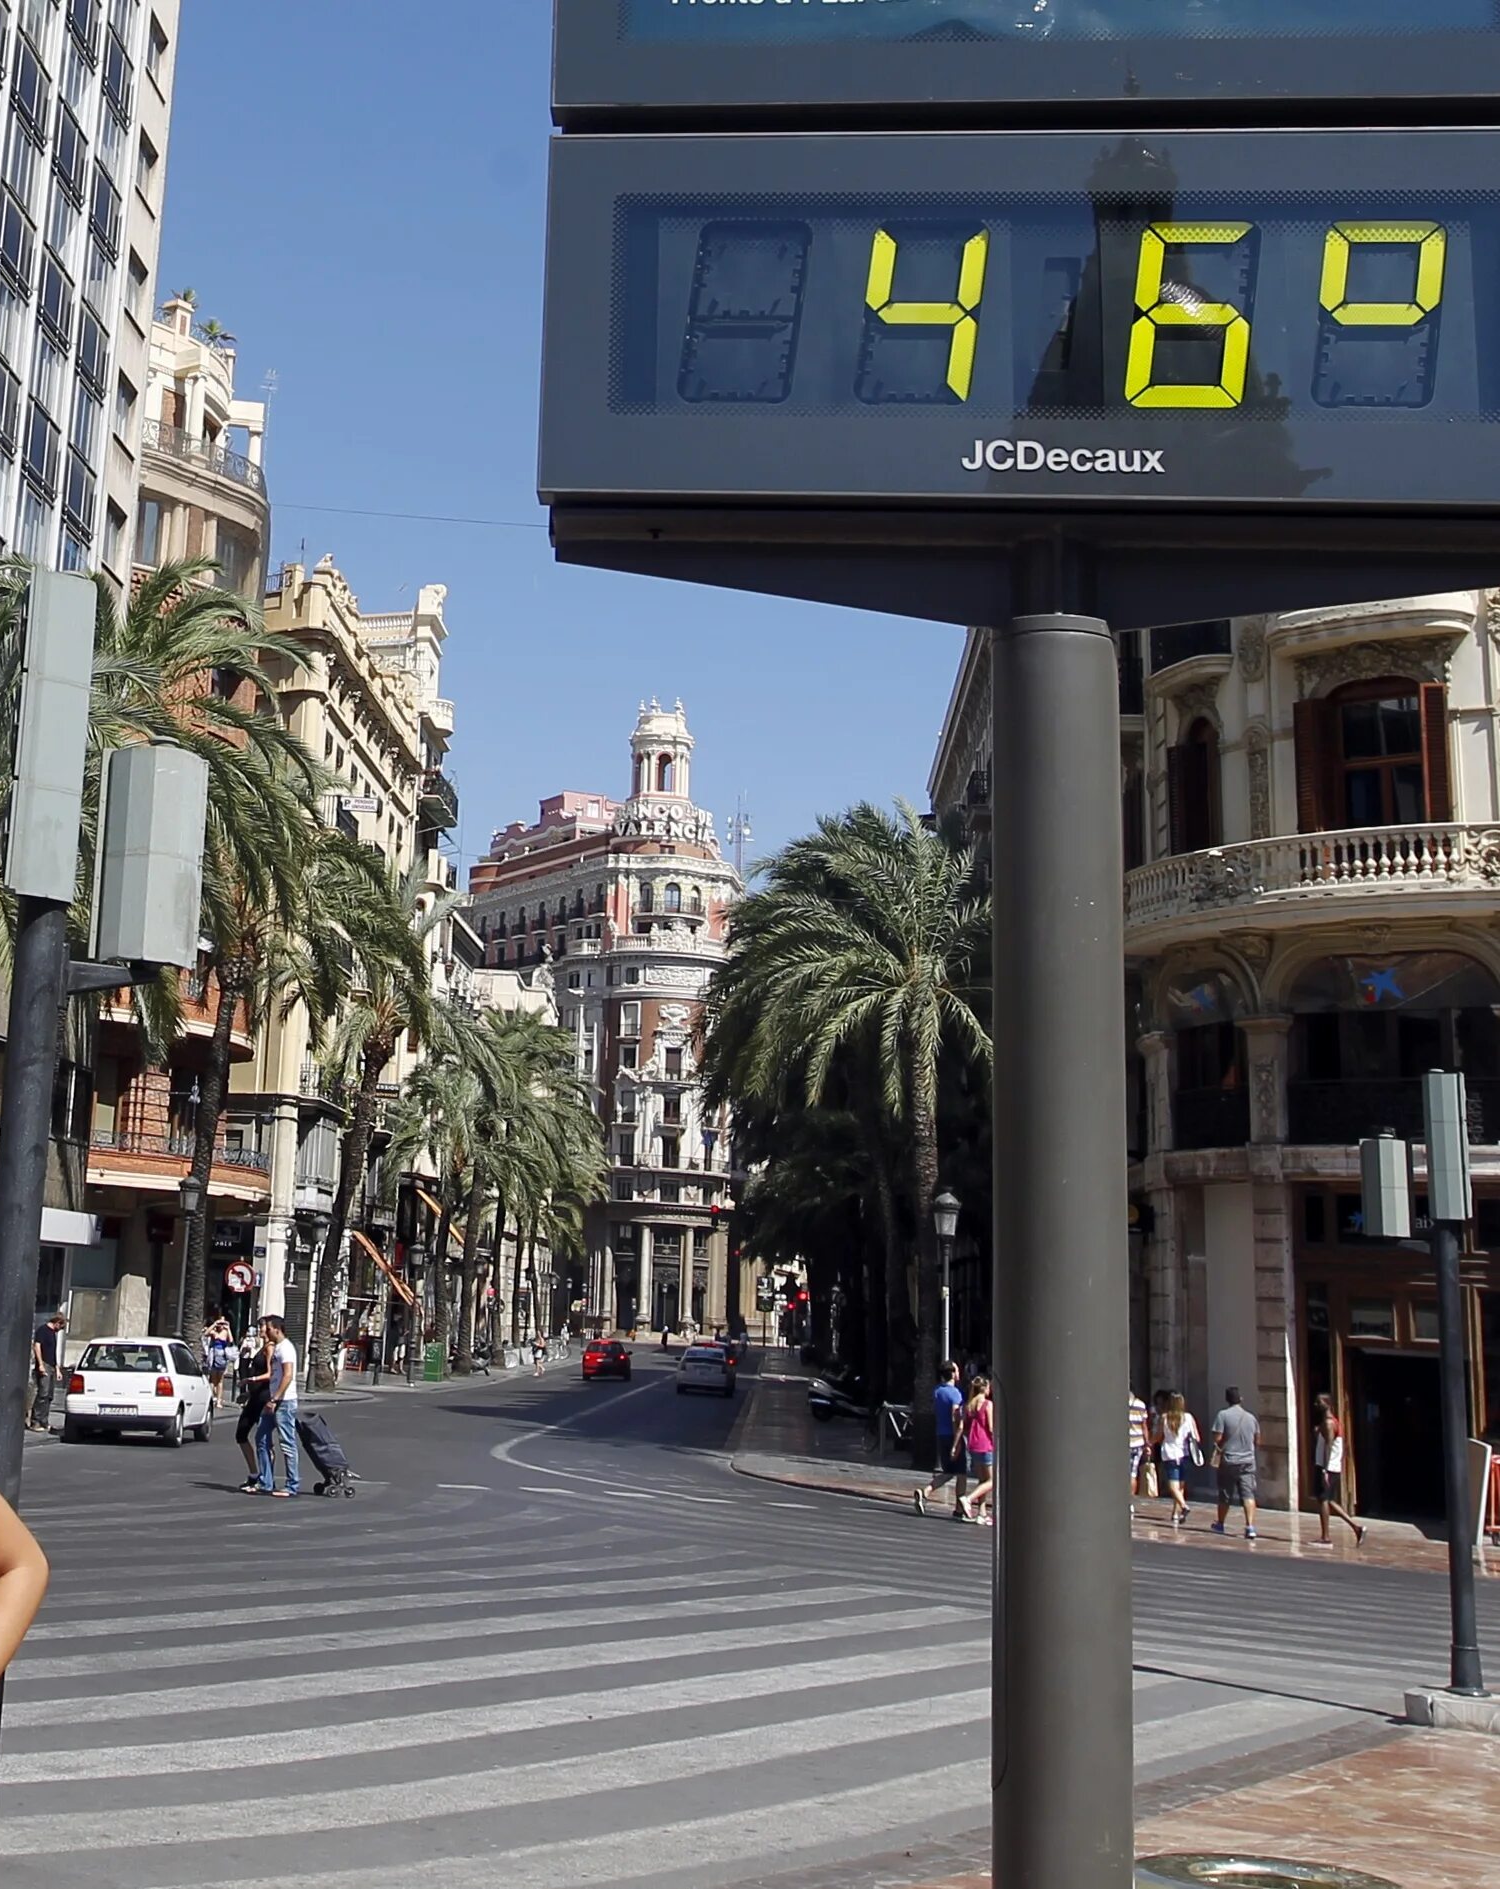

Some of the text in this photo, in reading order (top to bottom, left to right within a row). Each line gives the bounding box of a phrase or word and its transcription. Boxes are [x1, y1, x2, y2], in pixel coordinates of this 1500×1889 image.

[960, 440, 1166, 475] JCDecaux
[615, 803, 714, 828] BANCO DE
[614, 820, 715, 843] VALENCIA
